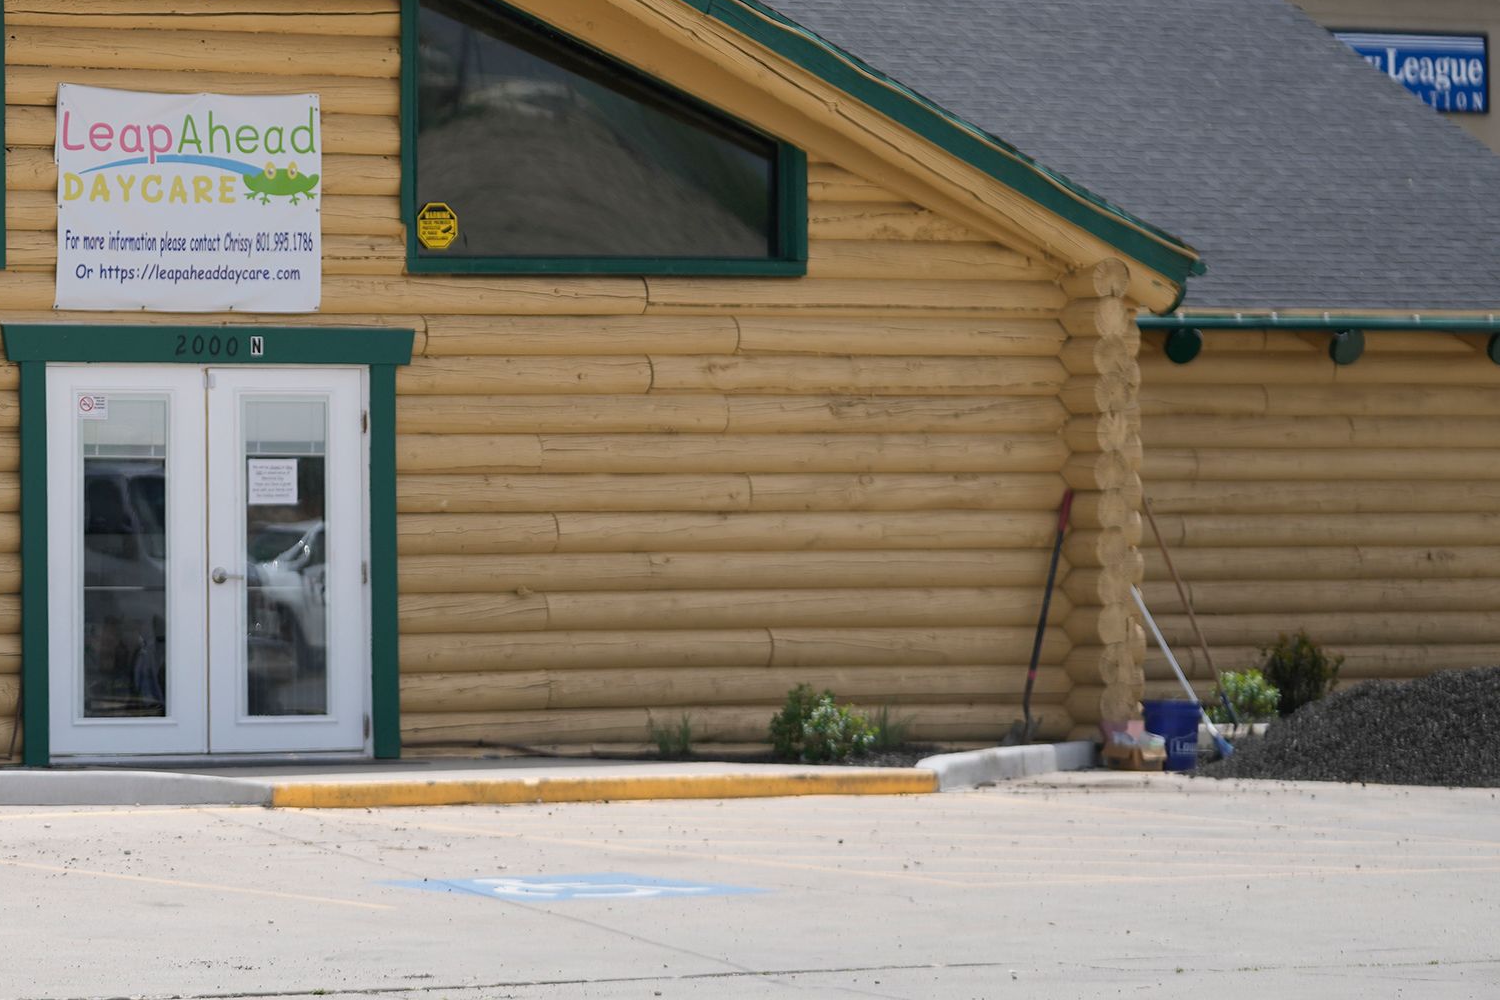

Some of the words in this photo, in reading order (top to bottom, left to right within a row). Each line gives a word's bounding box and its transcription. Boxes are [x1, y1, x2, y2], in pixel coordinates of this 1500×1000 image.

[1386, 48, 1484, 91] League
[63, 172, 237, 204] DAYCARE
[66, 229, 80, 250] For
[83, 235, 105, 251] more
[108, 229, 157, 251] information
[160, 231, 187, 257] please
[190, 233, 221, 252] contact
[224, 231, 253, 258] Chrissy
[256, 231, 313, 252] 801.995.1786
[76, 263, 94, 279] Or
[99, 263, 301, 285] https://leapaheaddaycare.com
[175, 334, 238, 356] 2000
[251, 337, 262, 354] N
